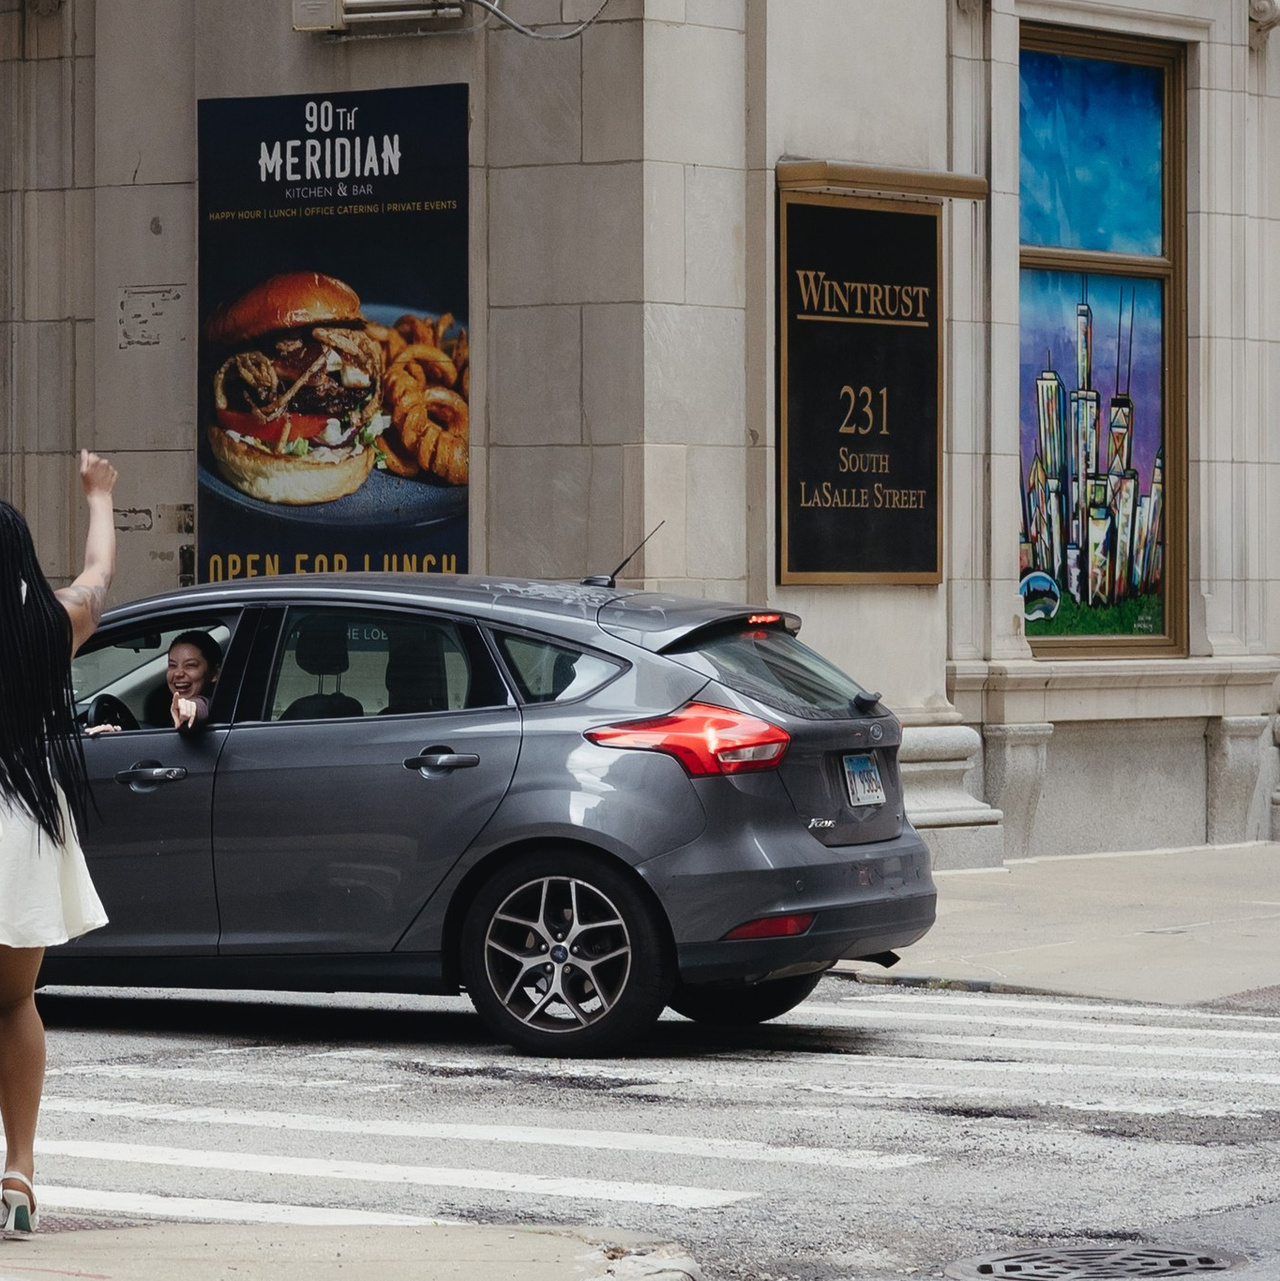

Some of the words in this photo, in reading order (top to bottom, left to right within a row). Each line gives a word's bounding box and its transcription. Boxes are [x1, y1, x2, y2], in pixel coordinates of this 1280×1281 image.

[258, 134, 402, 182] MERIDIAN
[285, 186, 333, 199] KITCHEN
[337, 182, 348, 197] &
[352, 184, 374, 196] BAR
[209, 212, 236, 221] HAPPY
[238, 210, 262, 219] HOUR
[269, 208, 297, 218] LUNCH
[304, 206, 335, 216] OFFICE
[337, 203, 379, 214] CATERING
[387, 201, 422, 212] PRIVATE
[424, 200, 458, 210] EVENTS
[796, 270, 930, 318] WINTRUST
[839, 385, 890, 435] 231
[839, 447, 890, 473] SOUTH
[874, 483, 926, 508] STREET
[209, 554, 279, 583] OPEN
